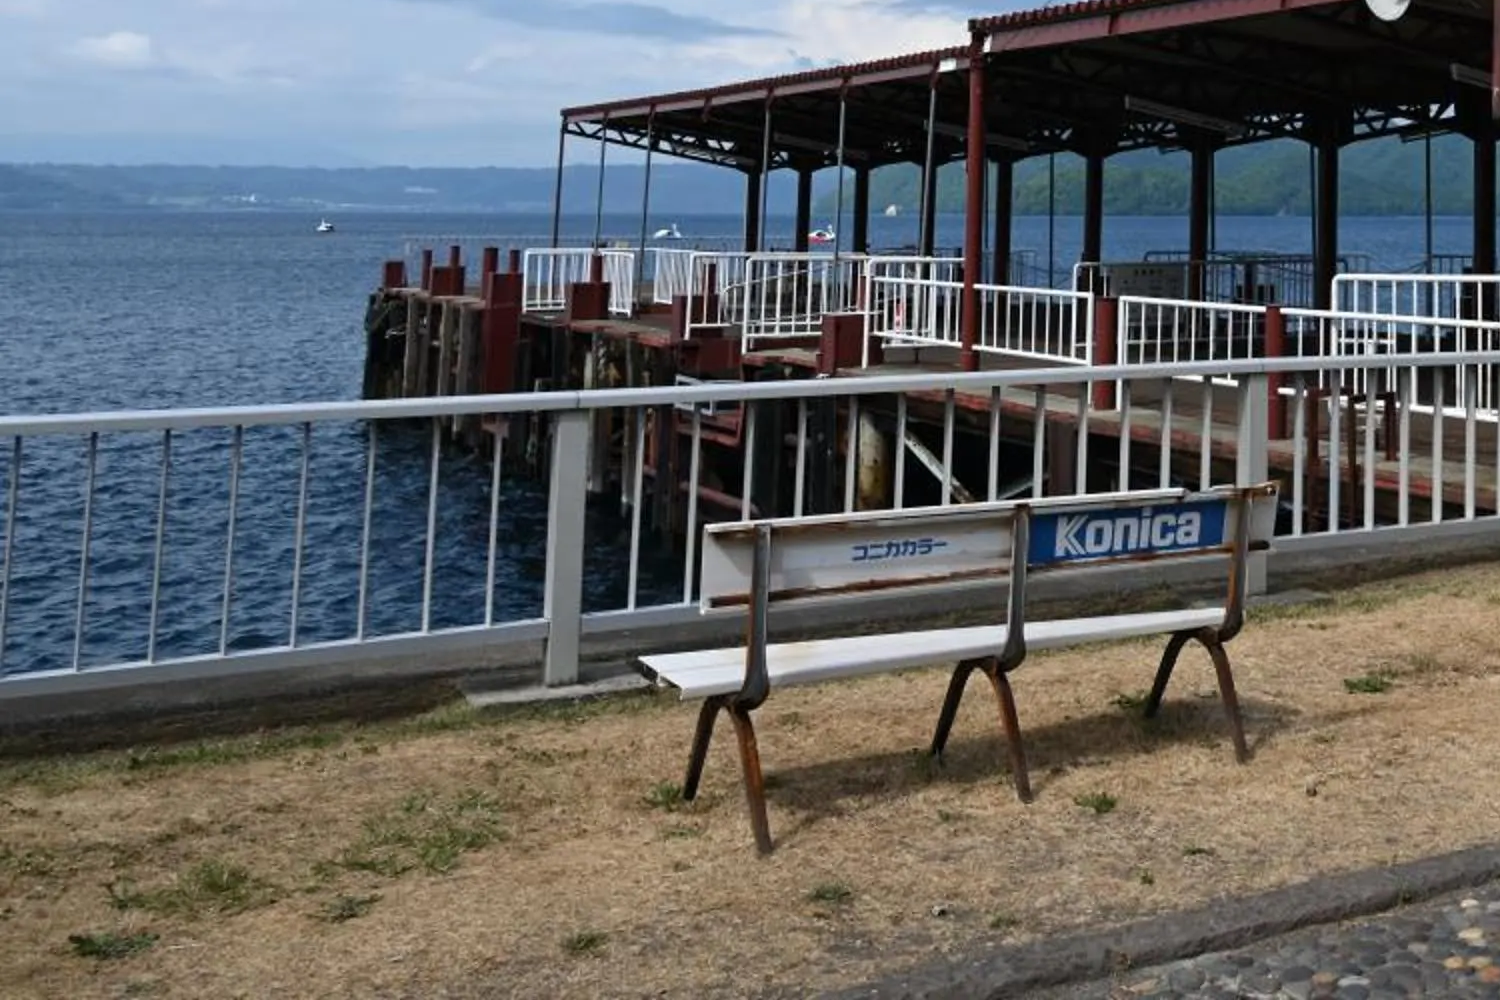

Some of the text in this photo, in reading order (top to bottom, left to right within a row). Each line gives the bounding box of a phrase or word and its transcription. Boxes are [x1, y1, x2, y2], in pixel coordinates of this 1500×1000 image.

[851, 538, 948, 562] コニカカラー
[1054, 509, 1201, 558] Konica
